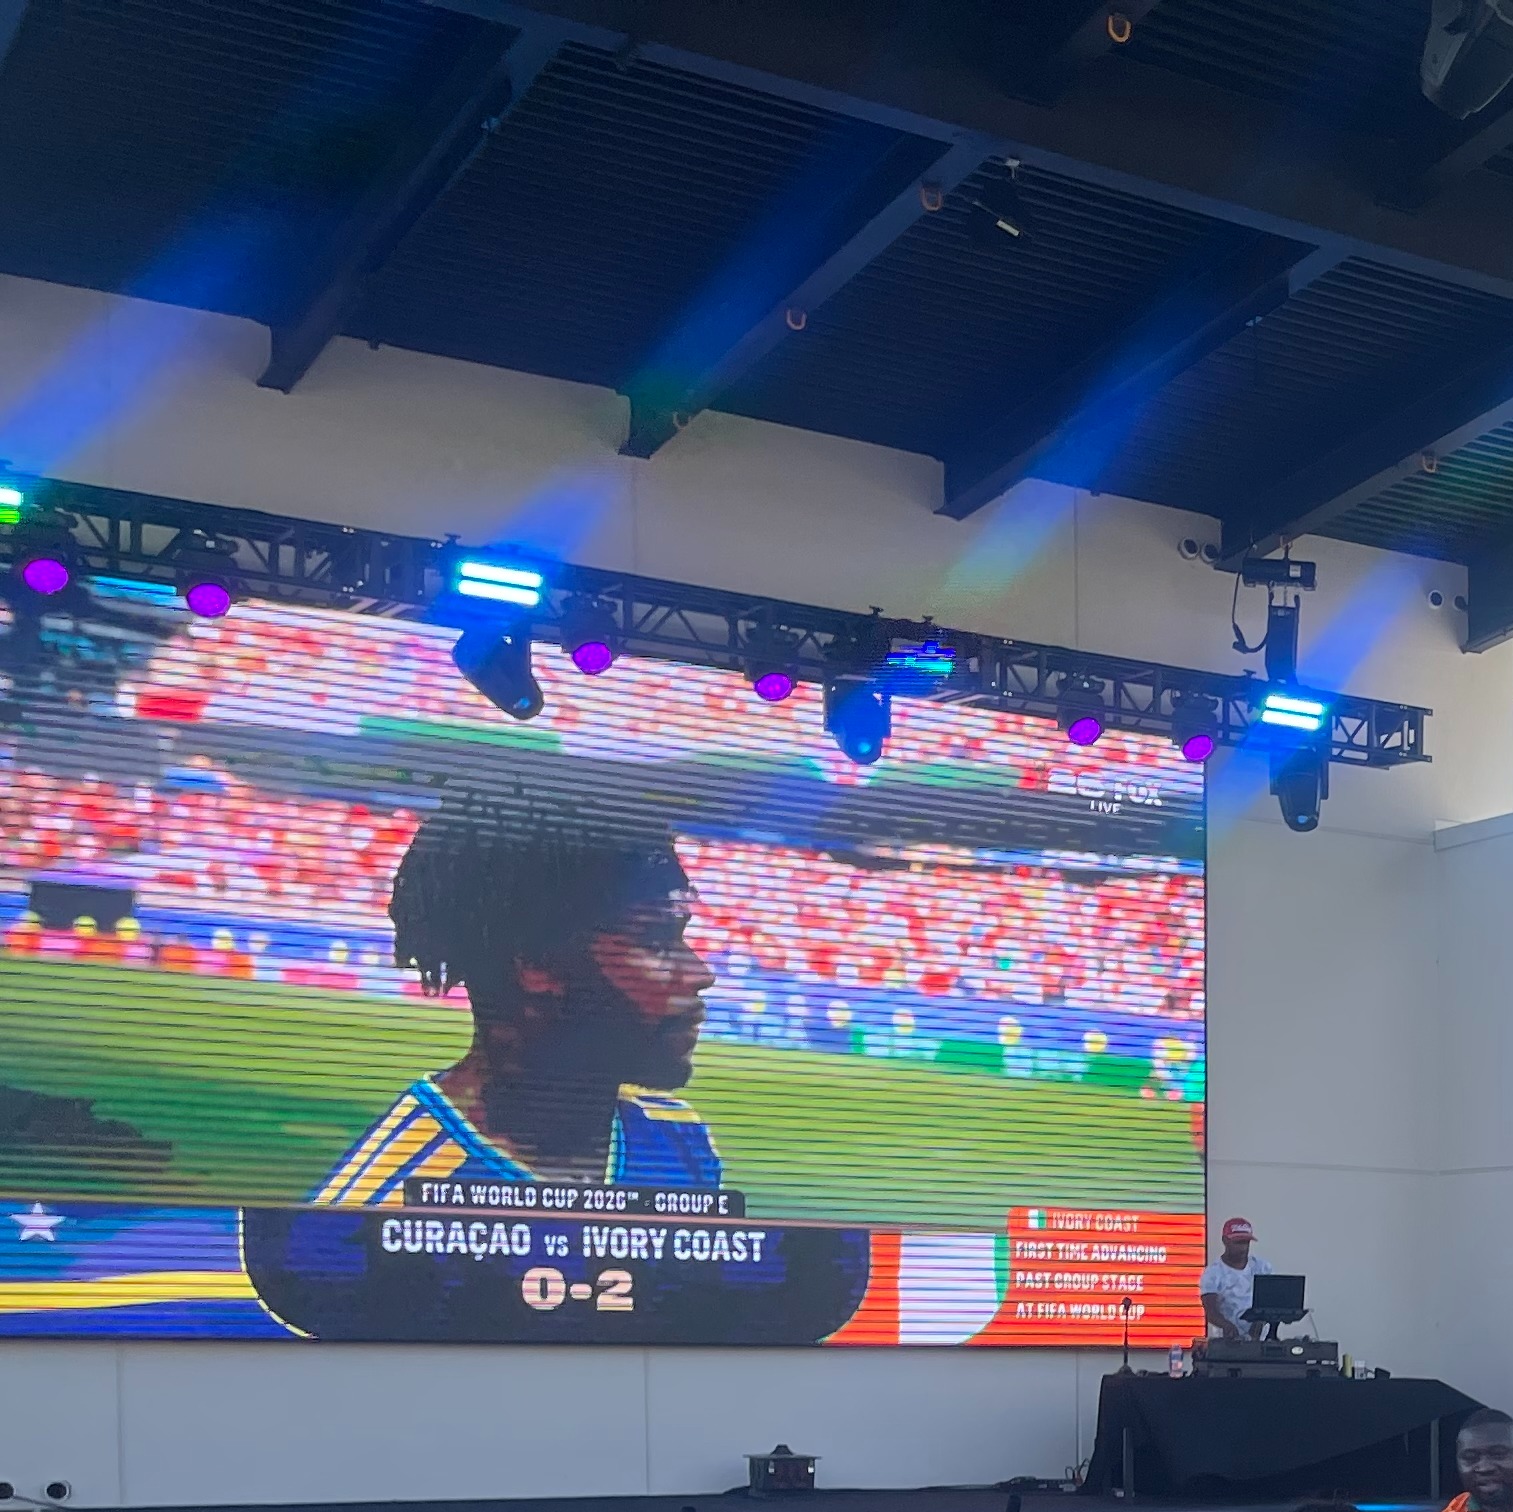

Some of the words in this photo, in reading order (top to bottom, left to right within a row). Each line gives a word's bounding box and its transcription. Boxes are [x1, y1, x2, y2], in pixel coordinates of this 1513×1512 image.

[421, 1183, 465, 1205] FIFA
[471, 1185, 537, 1208] WORLD
[542, 1187, 578, 1210] CUP
[654, 1192, 713, 1214] GROUP
[718, 1195, 730, 1215] E
[1052, 1212, 1092, 1230] IVORY
[1095, 1214, 1140, 1232] COAST
[381, 1218, 532, 1261] CURAÇAO
[583, 1226, 667, 1260] IVORY
[673, 1229, 766, 1263] COAST
[1016, 1241, 1054, 1259] FIRST
[1056, 1243, 1088, 1261] TIME
[1091, 1243, 1168, 1263] ADVANCING
[1016, 1271, 1051, 1289] PAST
[1054, 1272, 1099, 1290] GROUP
[1102, 1274, 1144, 1292] STAGE
[1016, 1302, 1033, 1318] AT
[1037, 1302, 1066, 1319] FIFA
[1069, 1303, 1116, 1320] WORLD
[1119, 1303, 1145, 1321] CUP
